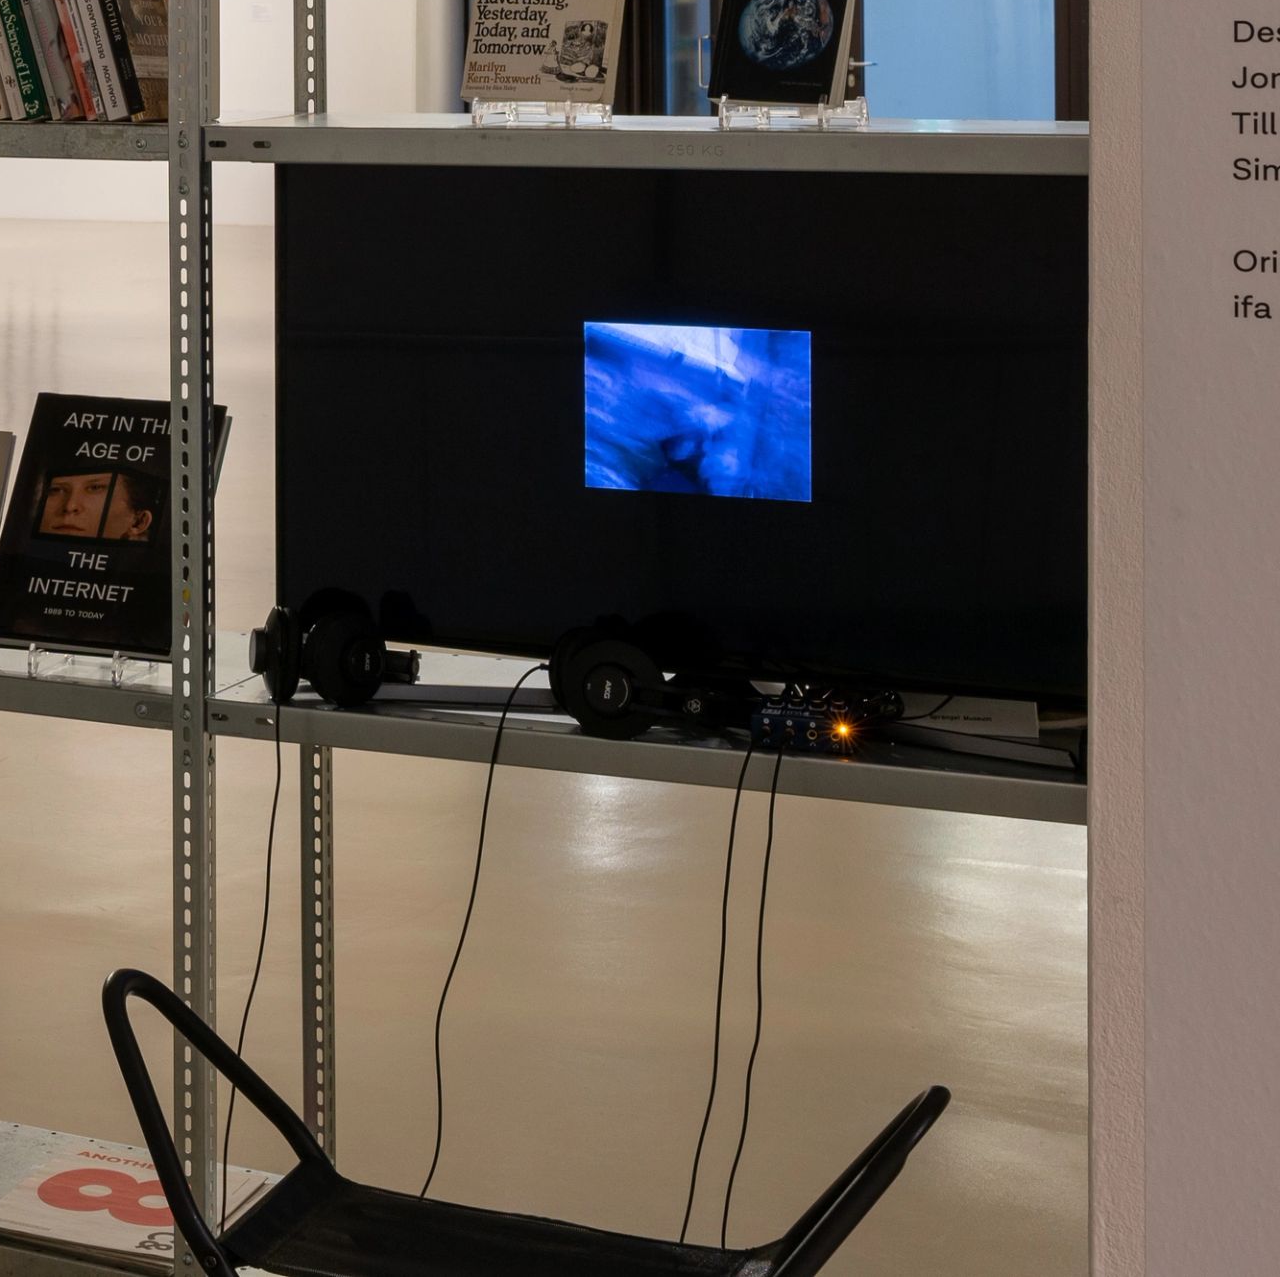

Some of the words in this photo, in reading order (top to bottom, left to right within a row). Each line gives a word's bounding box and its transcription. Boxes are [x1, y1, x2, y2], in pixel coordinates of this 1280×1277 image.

[476, 5, 548, 25] Yesterday,
[3, 14, 23, 58] Science
[85, 3, 105, 59] DEUTSCHLAND
[474, 21, 517, 41] Today,
[521, 23, 551, 38] and
[15, 56, 26, 71] of
[468, 61, 506, 73] Marilyn
[19, 70, 32, 95] Life
[101, 65, 112, 83] SOW
[467, 73, 541, 84] Kern-Foxworth
[106, 85, 118, 108] NOAH
[1231, 112, 1278, 135] Till
[1233, 250, 1278, 273] Ori
[1233, 295, 1272, 319] ifa
[64, 412, 108, 430] ART
[113, 415, 134, 432] IN
[75, 441, 121, 460] AGE
[126, 445, 155, 463] OF
[68, 551, 109, 571] THE
[28, 577, 134, 603] INTERNET
[65, 609, 75, 617] TO
[78, 610, 104, 620] TODAY
[603, 679, 612, 699] AKG
